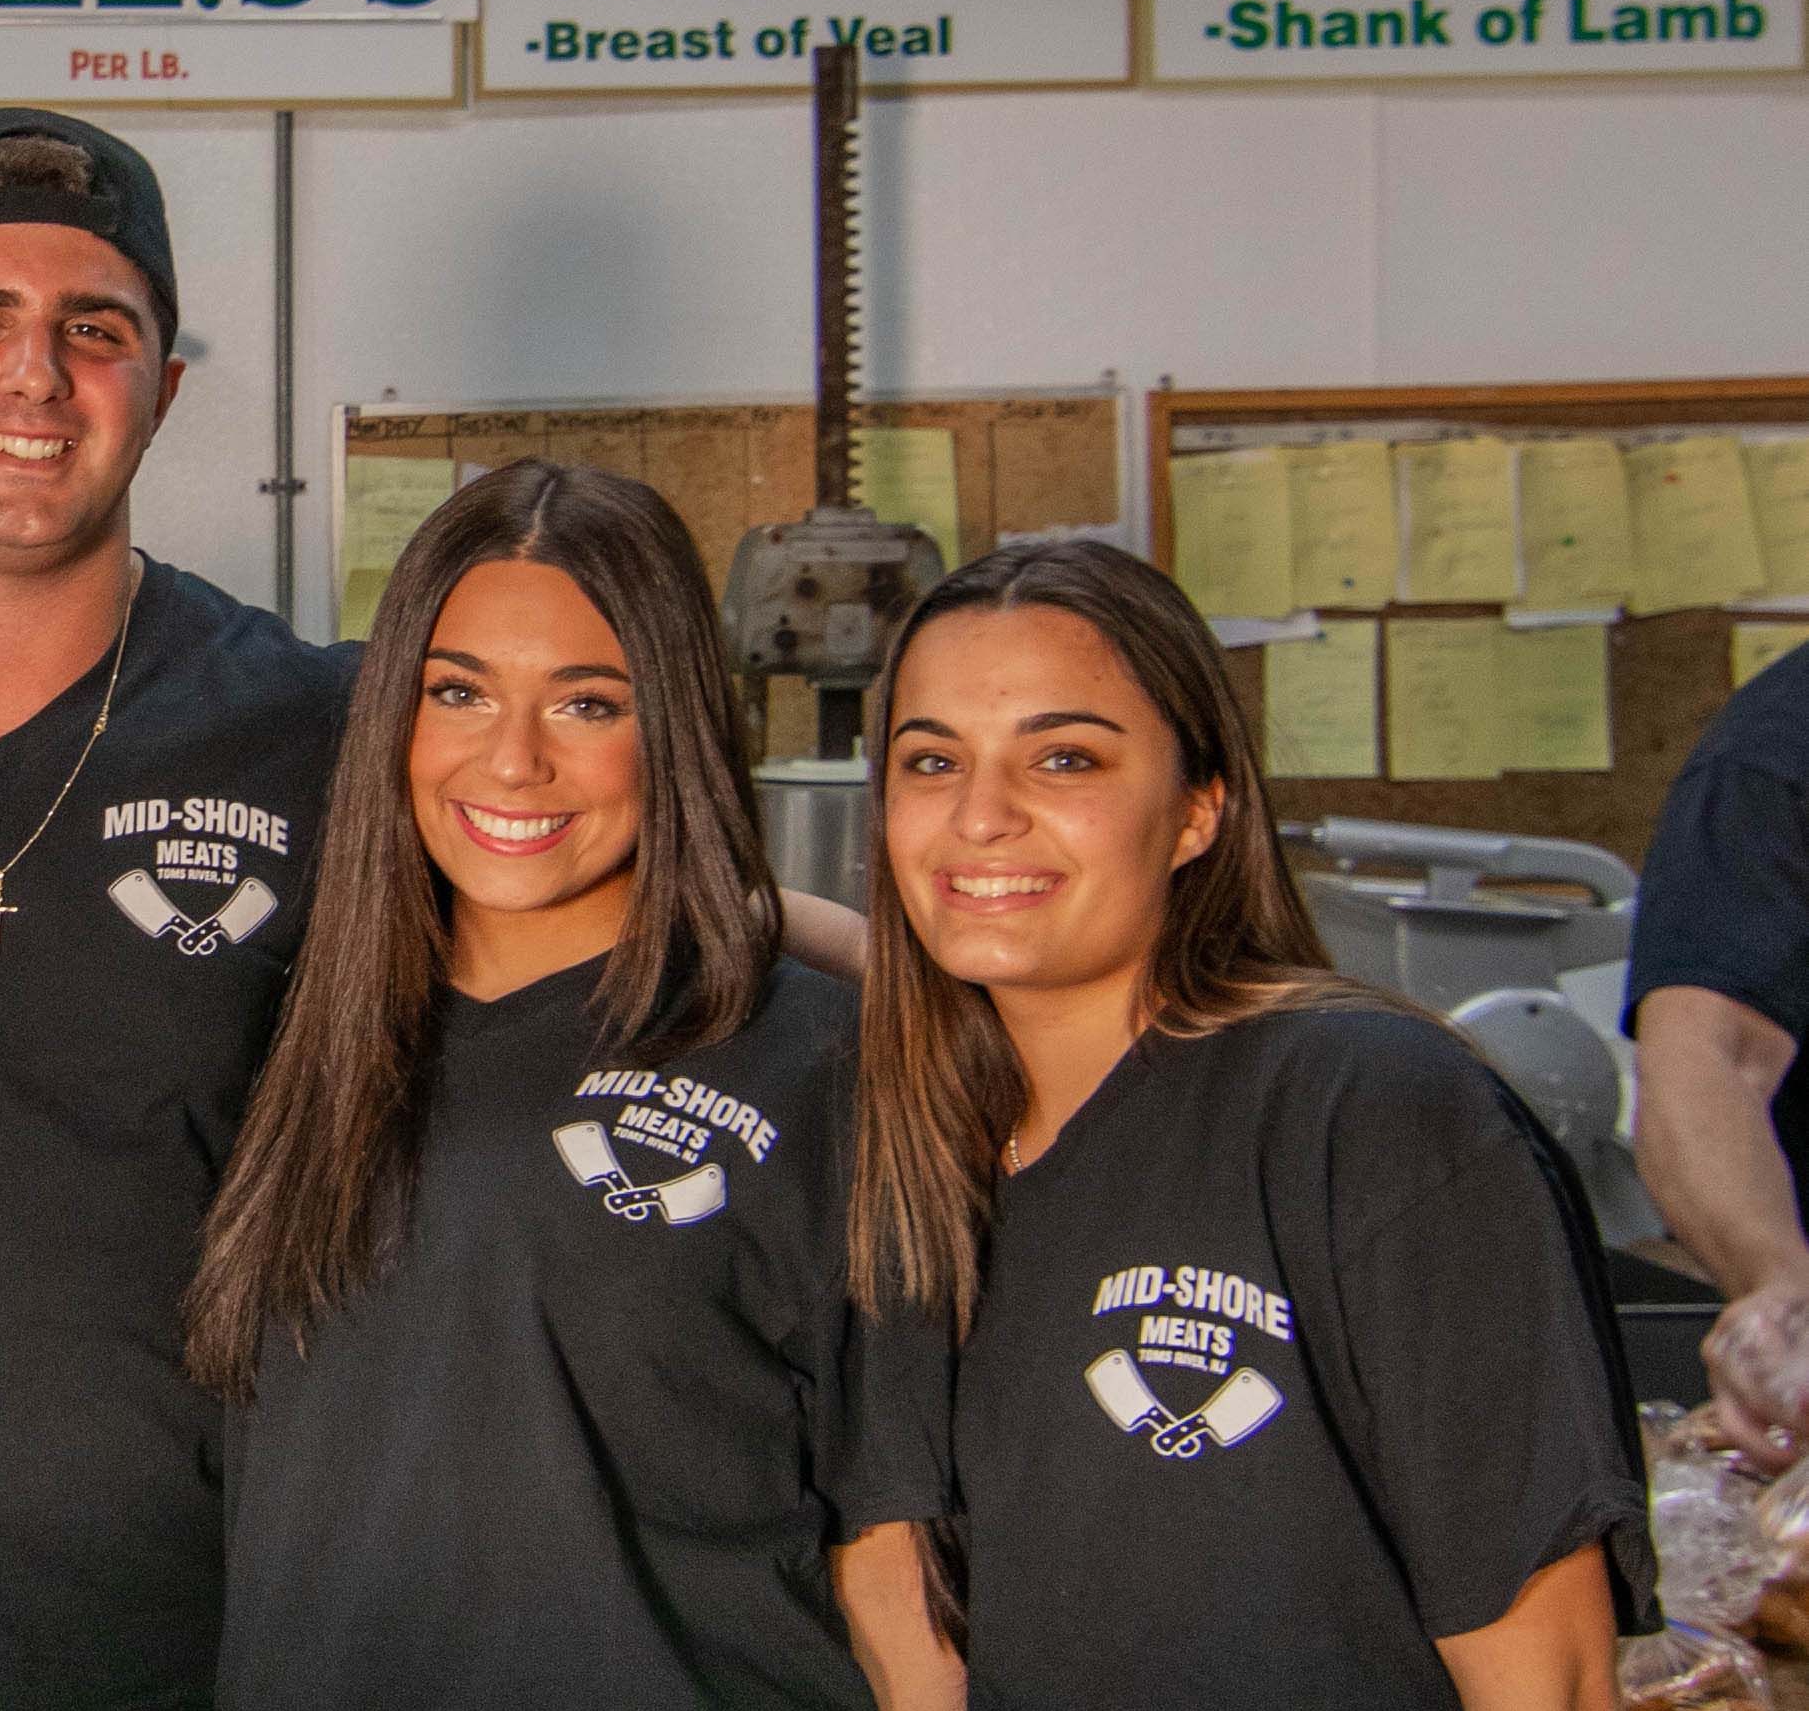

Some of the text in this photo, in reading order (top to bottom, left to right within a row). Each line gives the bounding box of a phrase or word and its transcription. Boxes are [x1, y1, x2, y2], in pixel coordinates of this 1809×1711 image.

[753, 19, 811, 58] of
[826, 16, 955, 58] Veal
[69, 51, 189, 81] PER LB.
[103, 798, 289, 855] MID-SHORE
[155, 839, 238, 869] MEATS
[574, 1070, 780, 1164] MID-SHORE
[617, 1103, 712, 1151] MEATS
[1092, 1265, 1295, 1341] MID-SHORE
[1139, 1315, 1235, 1358] MEATS
